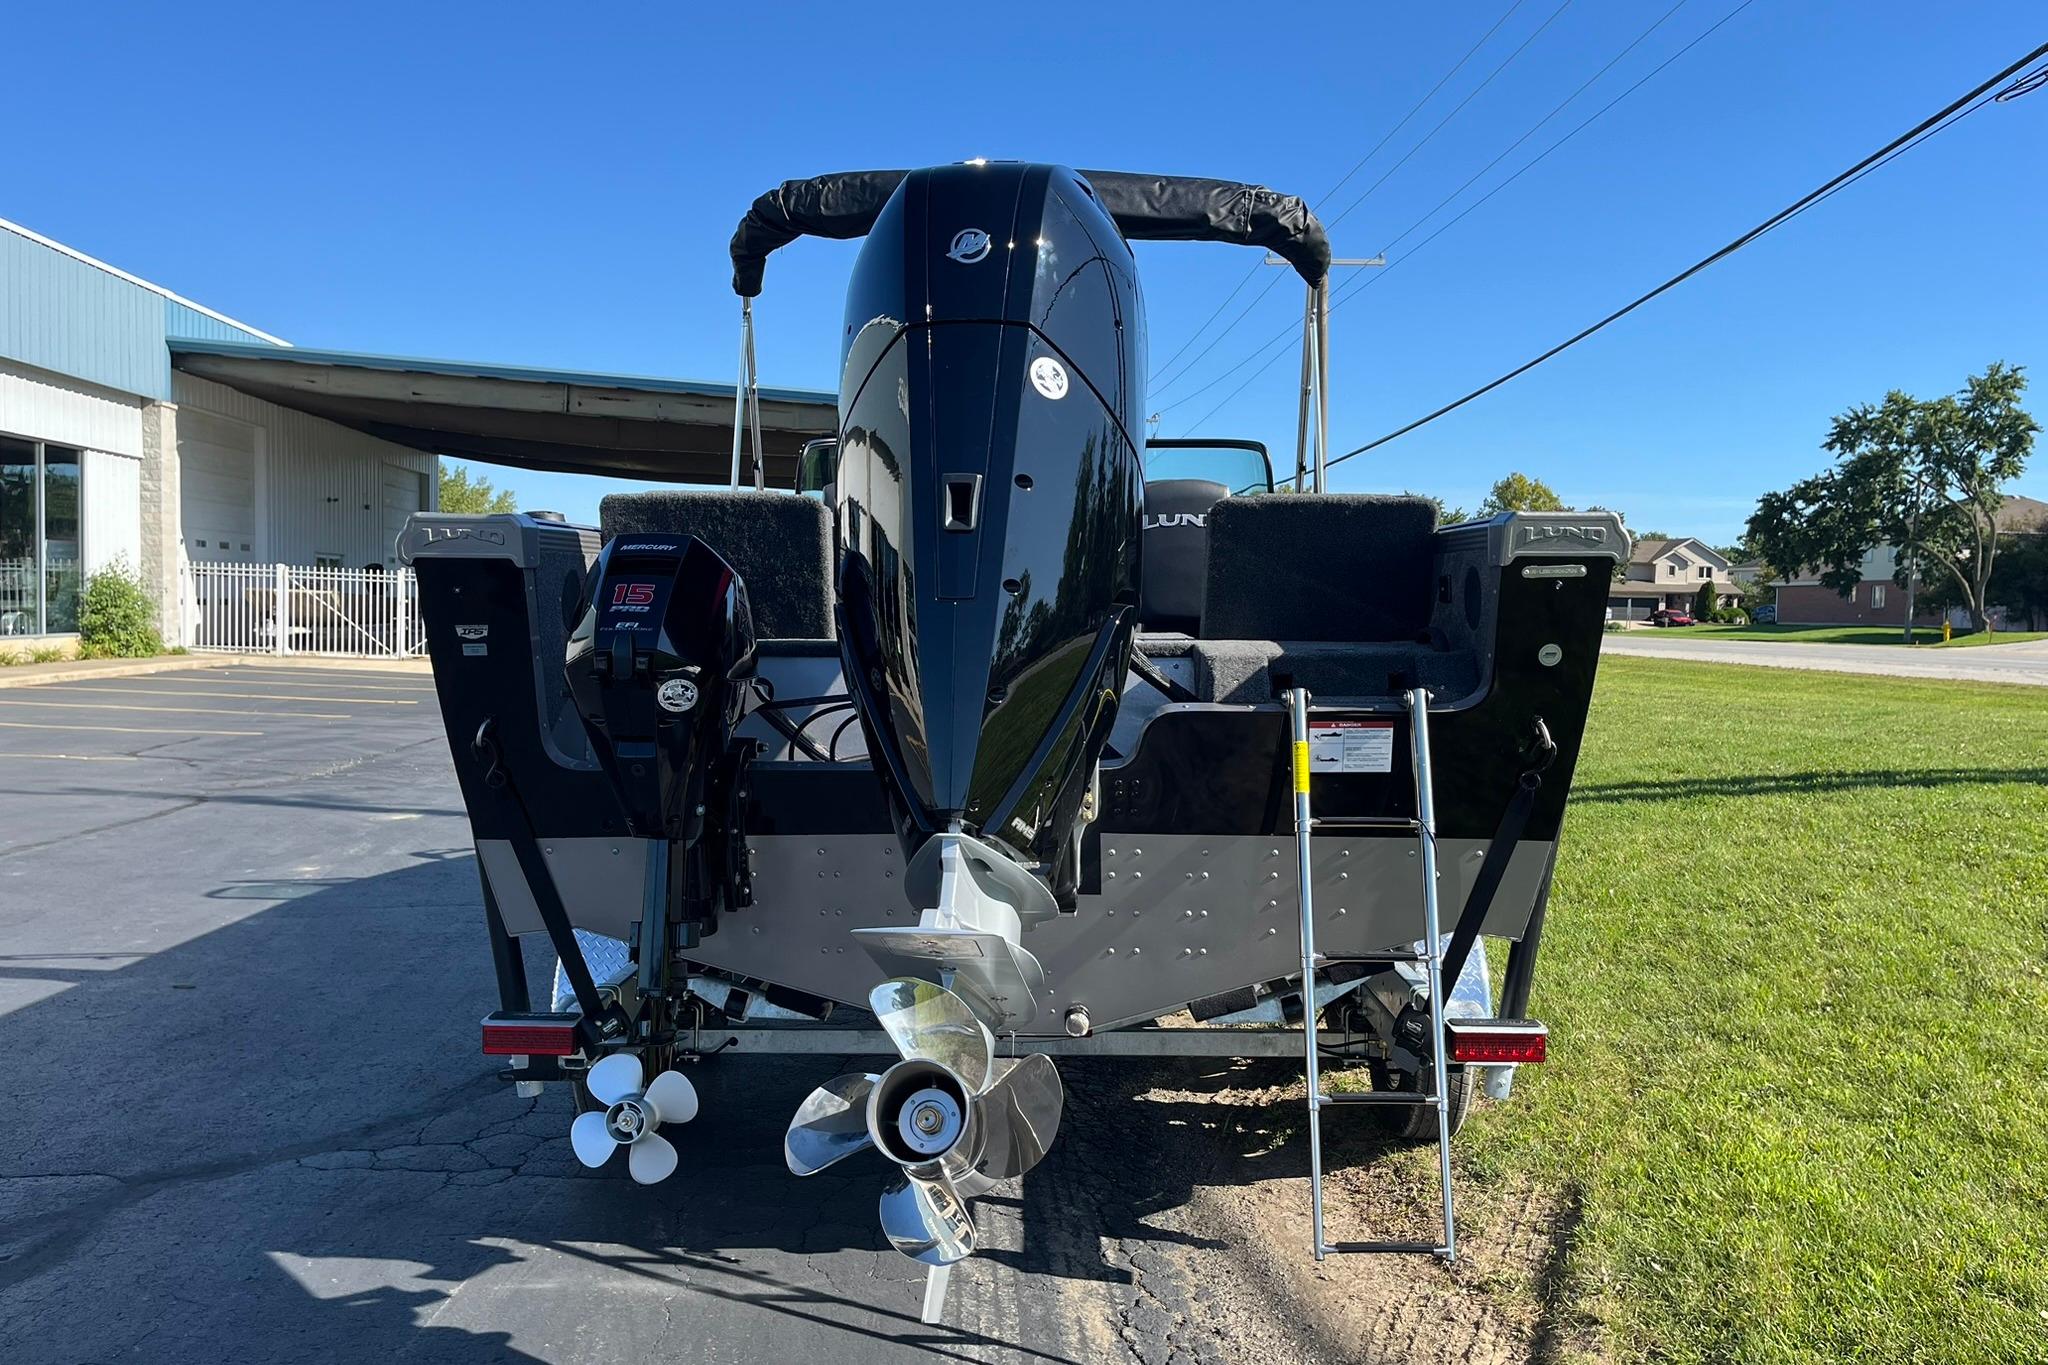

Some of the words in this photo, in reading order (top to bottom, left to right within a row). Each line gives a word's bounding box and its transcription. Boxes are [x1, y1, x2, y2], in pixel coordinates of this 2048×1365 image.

[1143, 513, 1208, 530] LUN
[421, 527, 505, 547] LUND
[1523, 526, 1607, 544] LUND
[612, 583, 656, 604] 15
[609, 605, 650, 613] PRO
